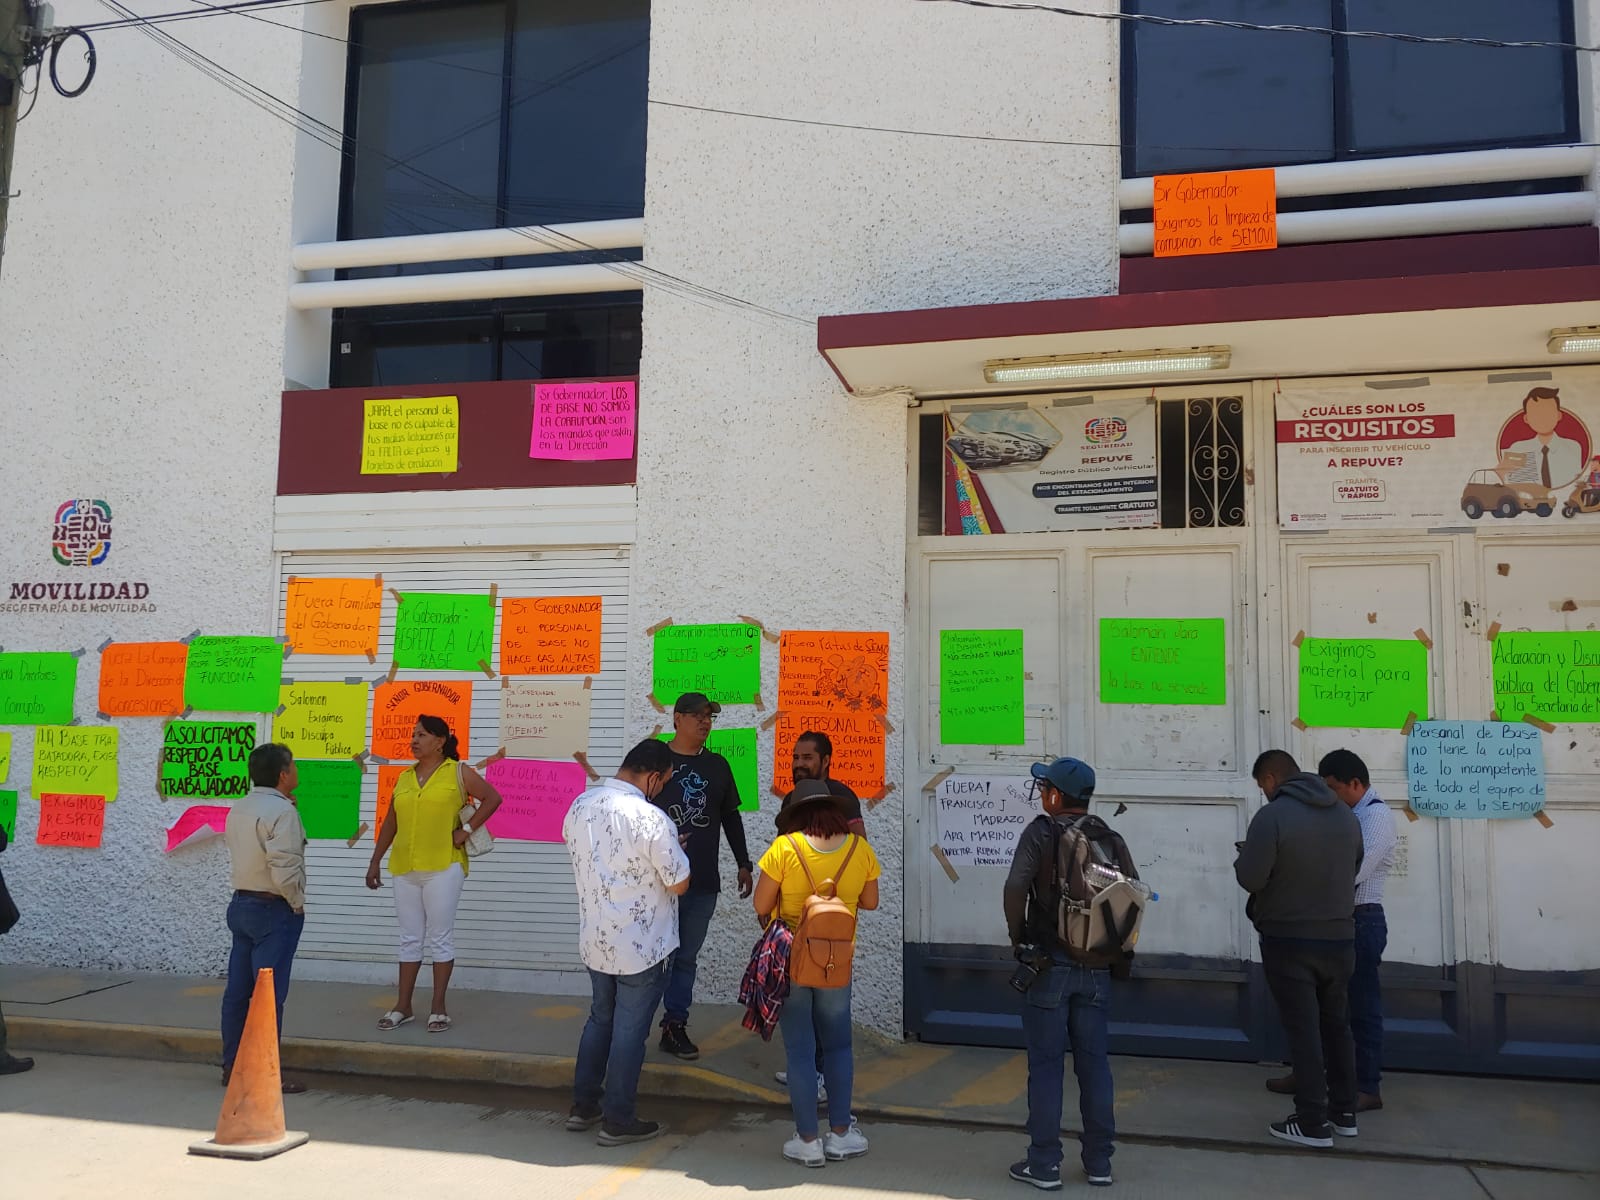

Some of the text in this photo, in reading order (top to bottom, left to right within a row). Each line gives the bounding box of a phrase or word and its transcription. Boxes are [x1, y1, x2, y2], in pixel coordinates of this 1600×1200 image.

[1155, 180, 1171, 201] Sr
[1154, 200, 1275, 232] Exigimos la limpieza de
[1210, 227, 1274, 250] de SEMOVI
[540, 387, 627, 400] Sr LOS
[394, 404, 452, 419] el personal de
[541, 401, 630, 414] DE BASE NO SOMOS
[1302, 403, 1425, 418] ¿CUÁLES SON LOS
[369, 420, 388, 429] base
[392, 421, 401, 429] no
[446, 419, 456, 428] de
[540, 416, 627, 427] LA son
[540, 429, 609, 440] los mandos que
[1295, 418, 1435, 441] REQUISITOS
[368, 447, 374, 456] la
[446, 446, 450, 455] y
[1327, 445, 1368, 453] INSCRIBIR
[1386, 443, 1431, 451] VEHÍCULO
[1081, 455, 1133, 464] REPUVE
[1328, 456, 1403, 467] A REPUVE?
[1052, 482, 1102, 490] ENCONTRAMOS
[1072, 487, 1133, 495] ESTACIONAMIENTO
[10, 582, 149, 600] MOVILIDAD
[71, 604, 88, 612] DE
[90, 604, 157, 612] MOVILIDAD
[510, 600, 527, 615] Sr
[516, 624, 592, 634] EL PERSONAL
[445, 628, 486, 652] A LA
[507, 640, 522, 648] DE
[575, 639, 590, 648] NO
[854, 640, 863, 651] de
[508, 655, 531, 664] HACE
[562, 654, 595, 663] ALTAS
[1131, 646, 1180, 664] ENTIENDE
[1309, 640, 1376, 663] Exigimos
[417, 653, 453, 668] BASE
[1558, 652, 1565, 669] y
[524, 665, 595, 673] VEHICULARES
[1301, 660, 1410, 685] material para
[200, 671, 255, 684] FUNCIONA
[696, 675, 716, 690] BASE
[1544, 670, 1559, 693] del
[414, 682, 461, 705] GOBERNADOR
[1312, 683, 1375, 707] Trabajar
[1496, 701, 1505, 721] y
[1514, 696, 1524, 711] la
[1582, 698, 1593, 712] de
[779, 716, 881, 733] EL PERSONAL DE
[1412, 723, 1538, 739] Personal de Base
[281, 727, 294, 739] Una
[844, 735, 883, 744] CULPABLE
[163, 746, 245, 764] RESPETO A LA
[836, 749, 872, 758] SEMOVI
[1411, 742, 1531, 759] no tiene la culpa
[189, 762, 221, 777] BASE
[489, 766, 504, 776] NO
[1413, 760, 1538, 779] de lo incompetente
[161, 776, 248, 796] TRABAJADORA
[945, 780, 991, 796] FUERA!
[1414, 779, 1544, 800] de todo el equipo de
[940, 798, 1006, 811] FRANCISCO J
[1412, 797, 1448, 814] Trabajo
[1454, 800, 1466, 810] de
[1492, 802, 1541, 811] SEMOVI
[46, 814, 100, 827] RESPETO
[973, 814, 1024, 825] MADRAZO
[971, 830, 1014, 841] MARINO
[942, 847, 972, 856] DIRECTOR
